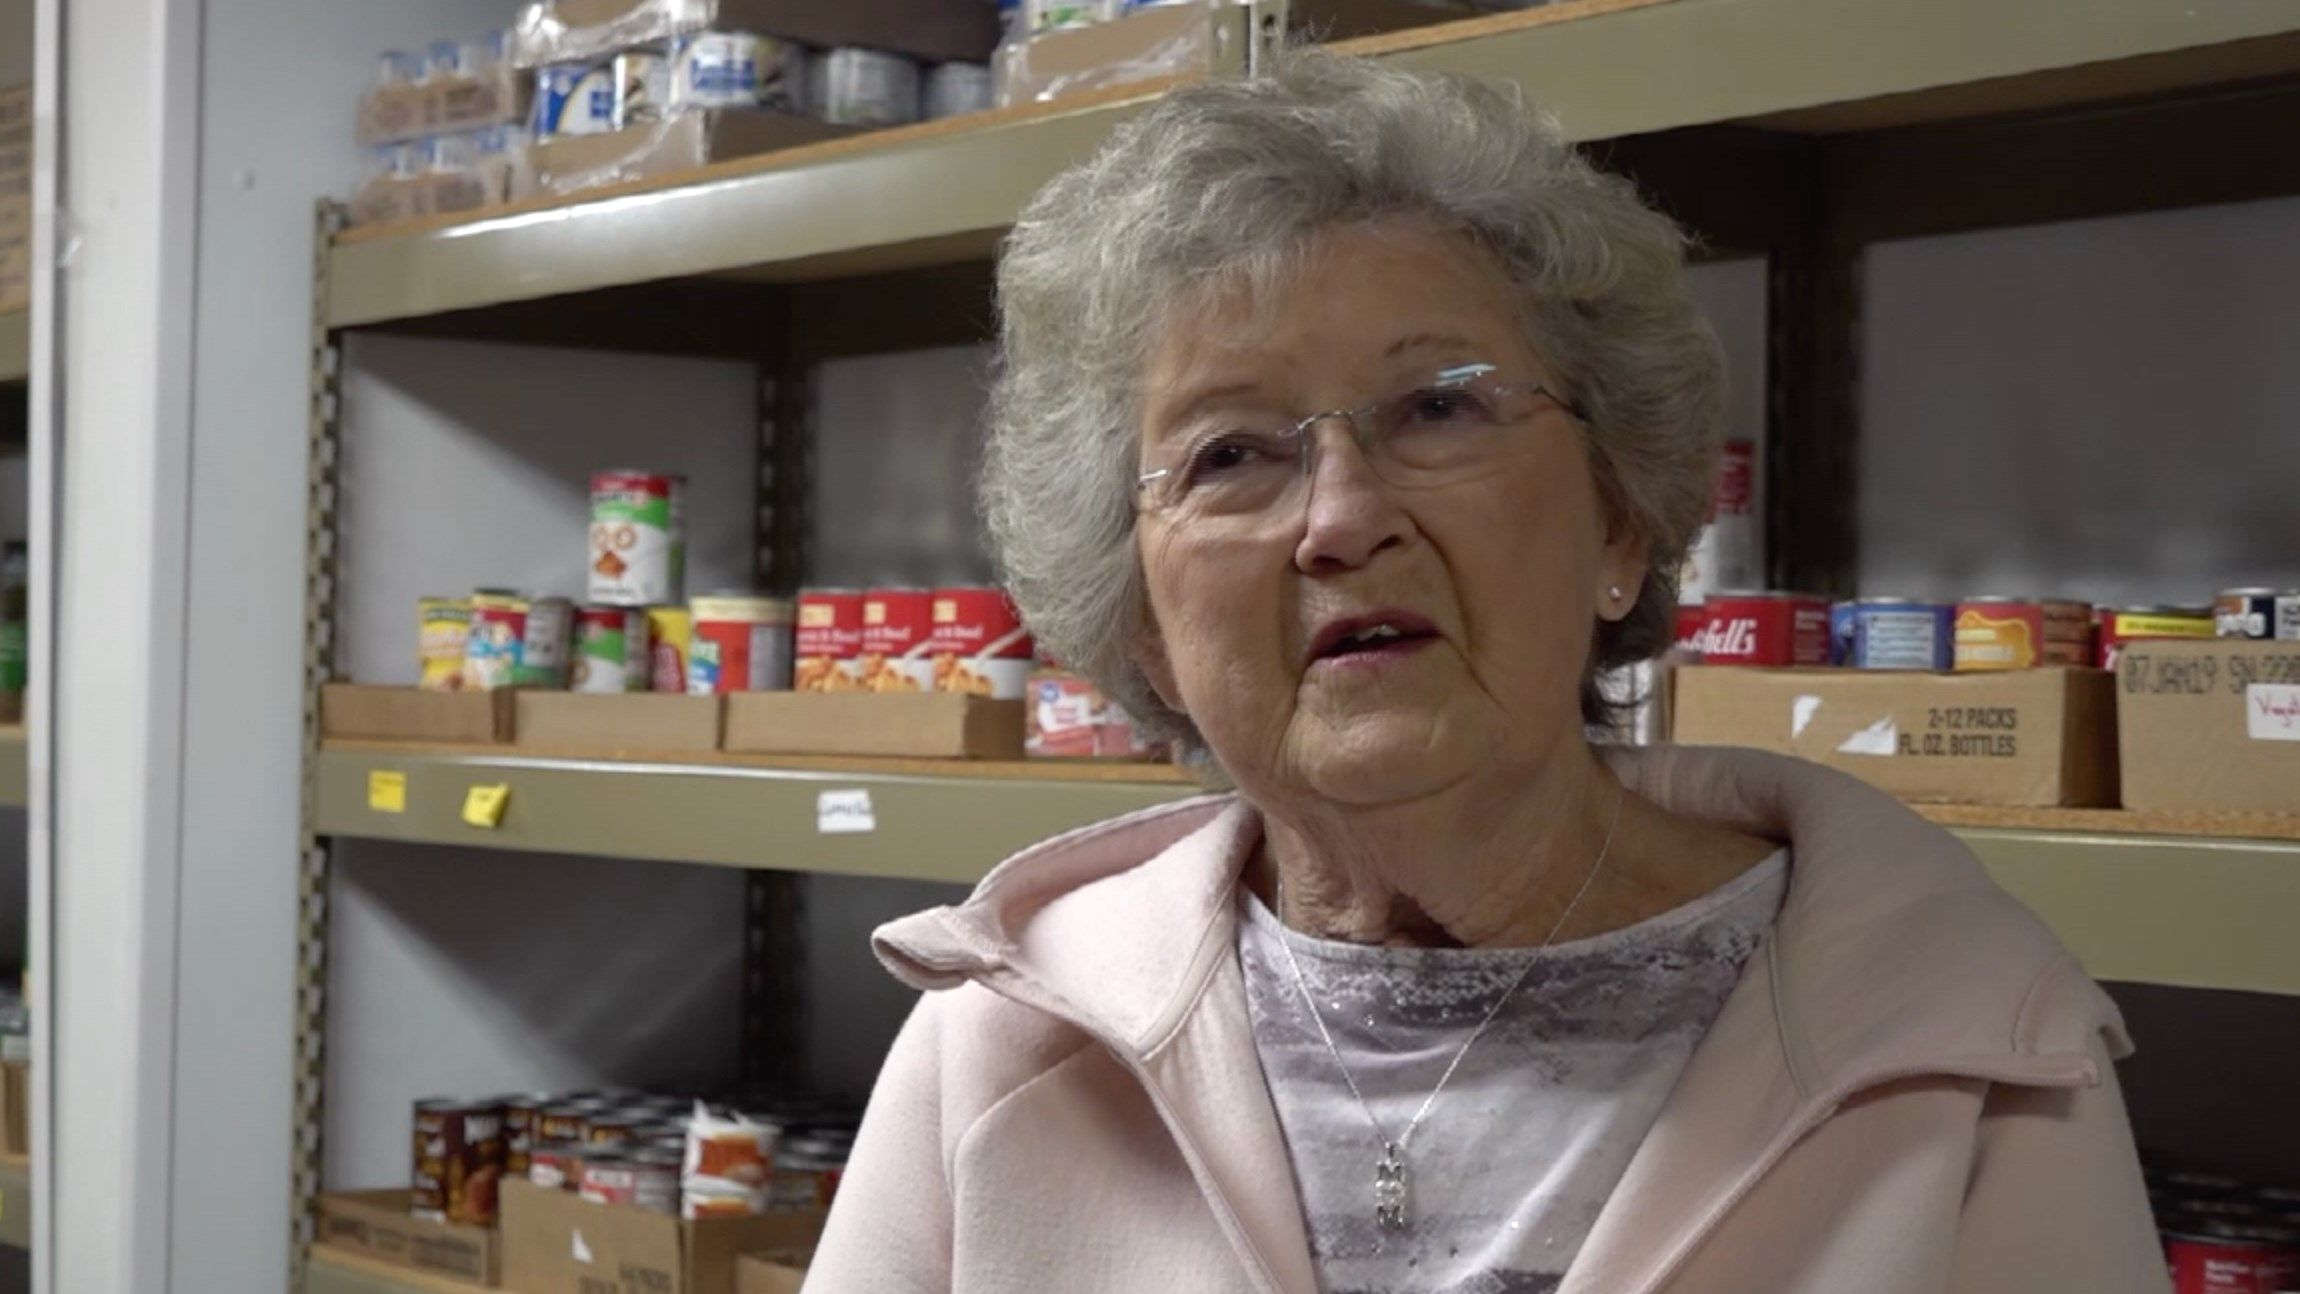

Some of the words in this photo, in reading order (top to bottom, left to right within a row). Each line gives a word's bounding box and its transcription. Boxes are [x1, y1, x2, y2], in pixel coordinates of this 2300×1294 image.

[1927, 707, 1963, 729] 2-12
[1967, 707, 2017, 730] PACKS
[1949, 733, 2017, 757] BOTTLES
